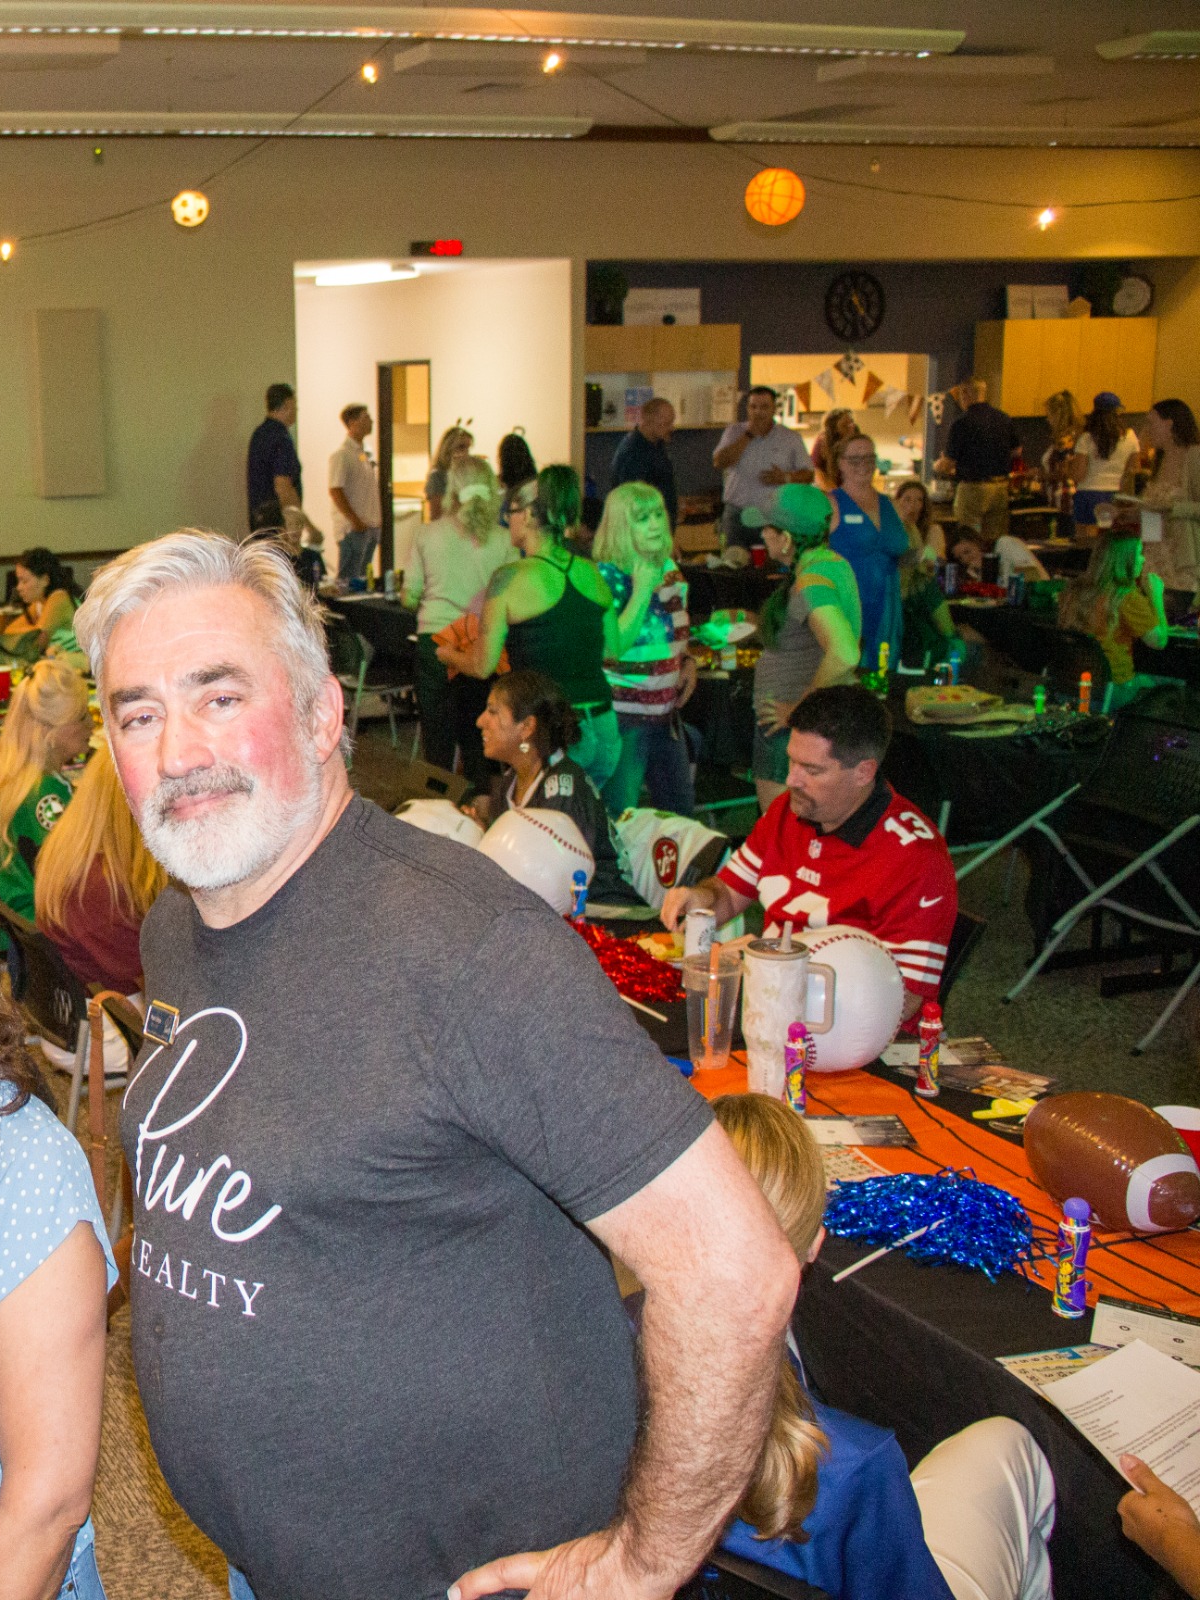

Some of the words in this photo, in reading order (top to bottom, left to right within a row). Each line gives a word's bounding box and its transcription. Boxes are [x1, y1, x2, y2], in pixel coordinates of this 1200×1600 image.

[884, 811, 934, 846] 13
[123, 1007, 283, 1243] Pure
[132, 1231, 264, 1317] EALTY
